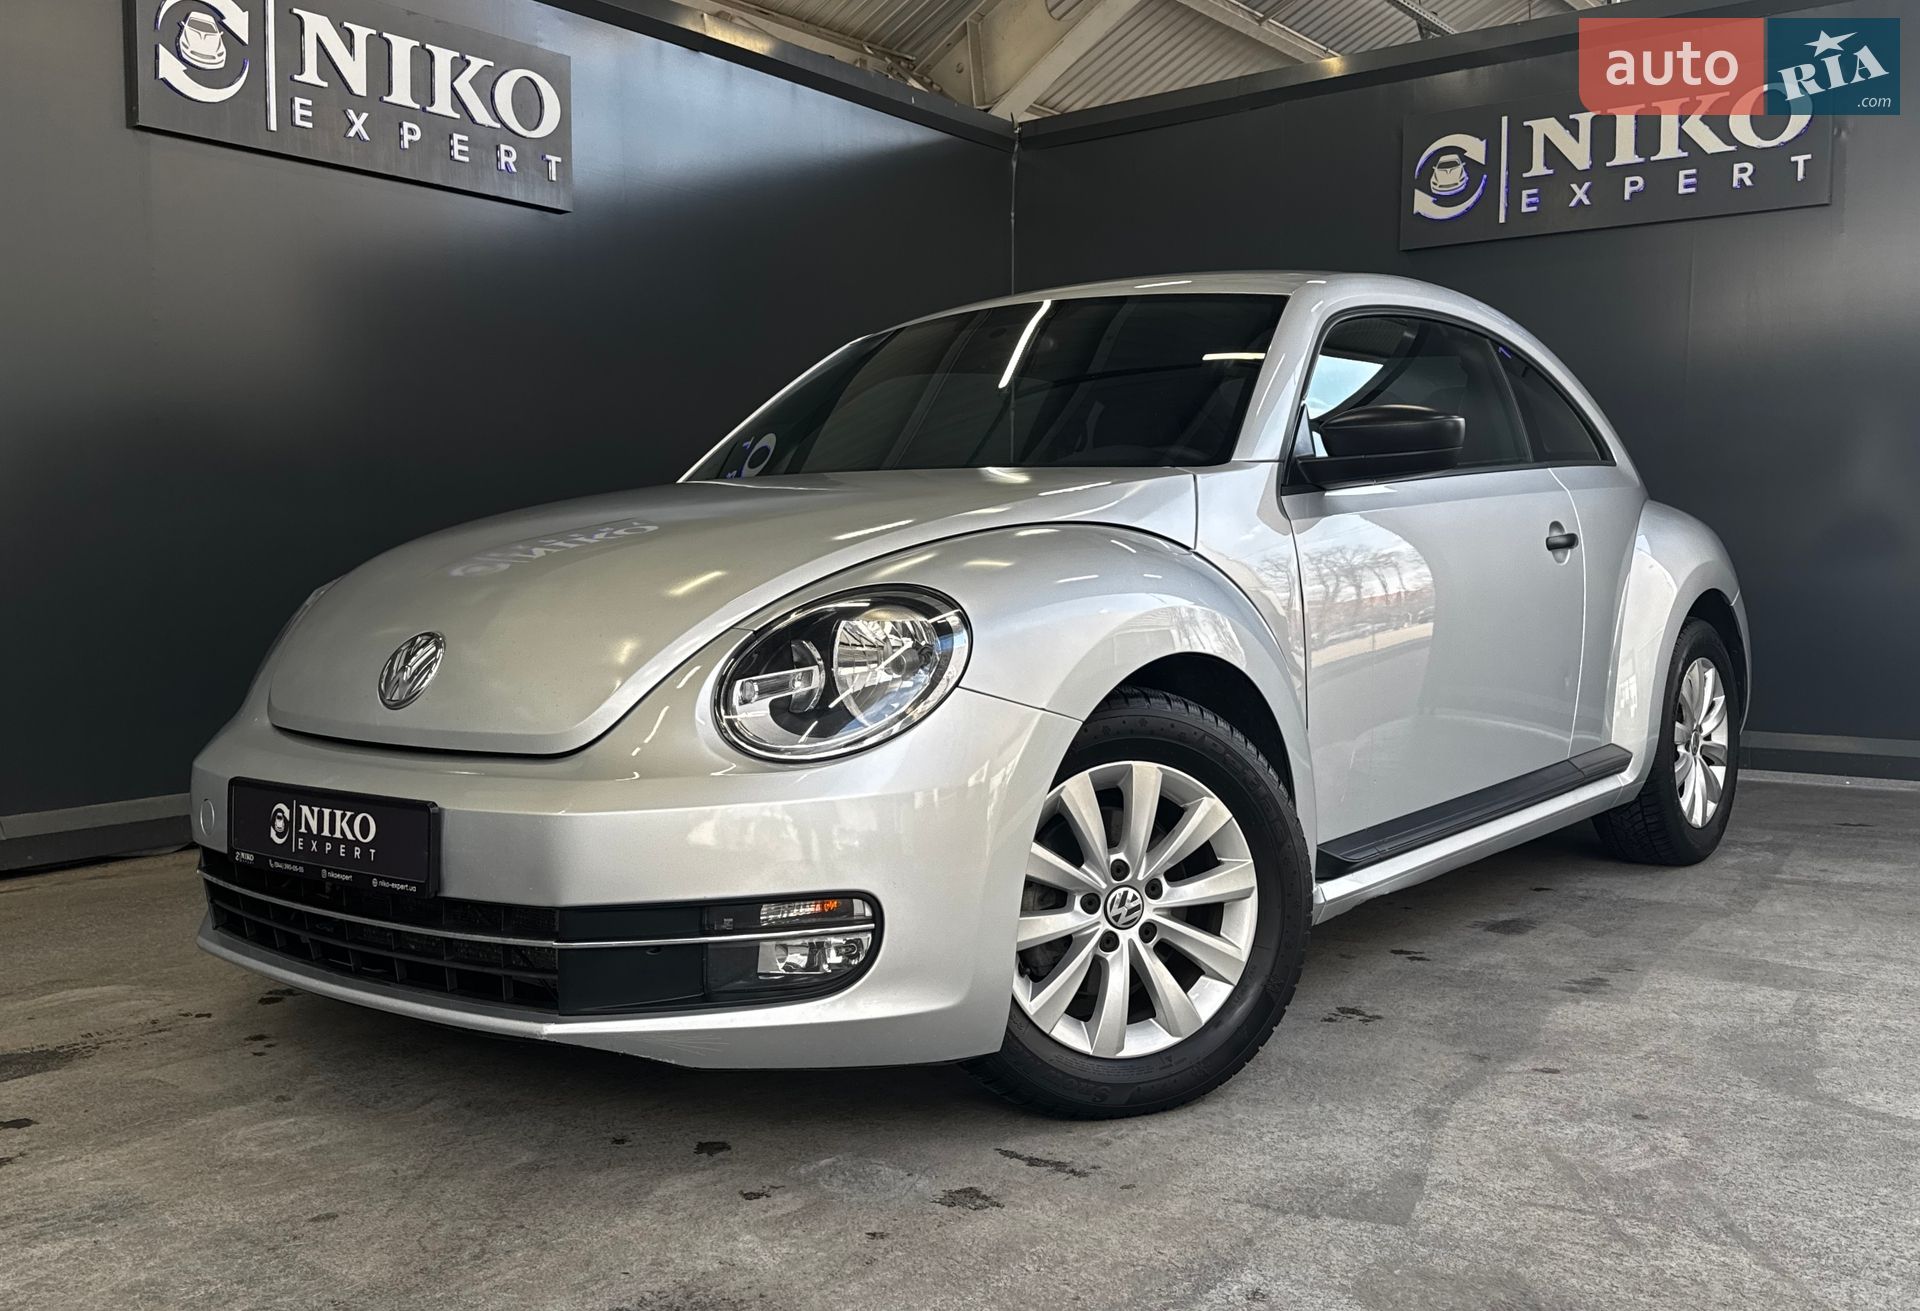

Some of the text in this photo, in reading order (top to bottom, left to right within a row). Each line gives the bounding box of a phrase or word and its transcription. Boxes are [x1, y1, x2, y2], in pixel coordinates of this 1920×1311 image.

[291, 8, 562, 139] NIKO
[292, 96, 562, 182] EXPERT
[1521, 82, 1813, 178] NIKO
[1520, 153, 1813, 213] EXPERT
[298, 804, 377, 843] NIKO
[298, 837, 376, 862] EXPERT
[327, 871, 353, 881] nikoexpert
[378, 880, 417, 892] niko-expert.ua
